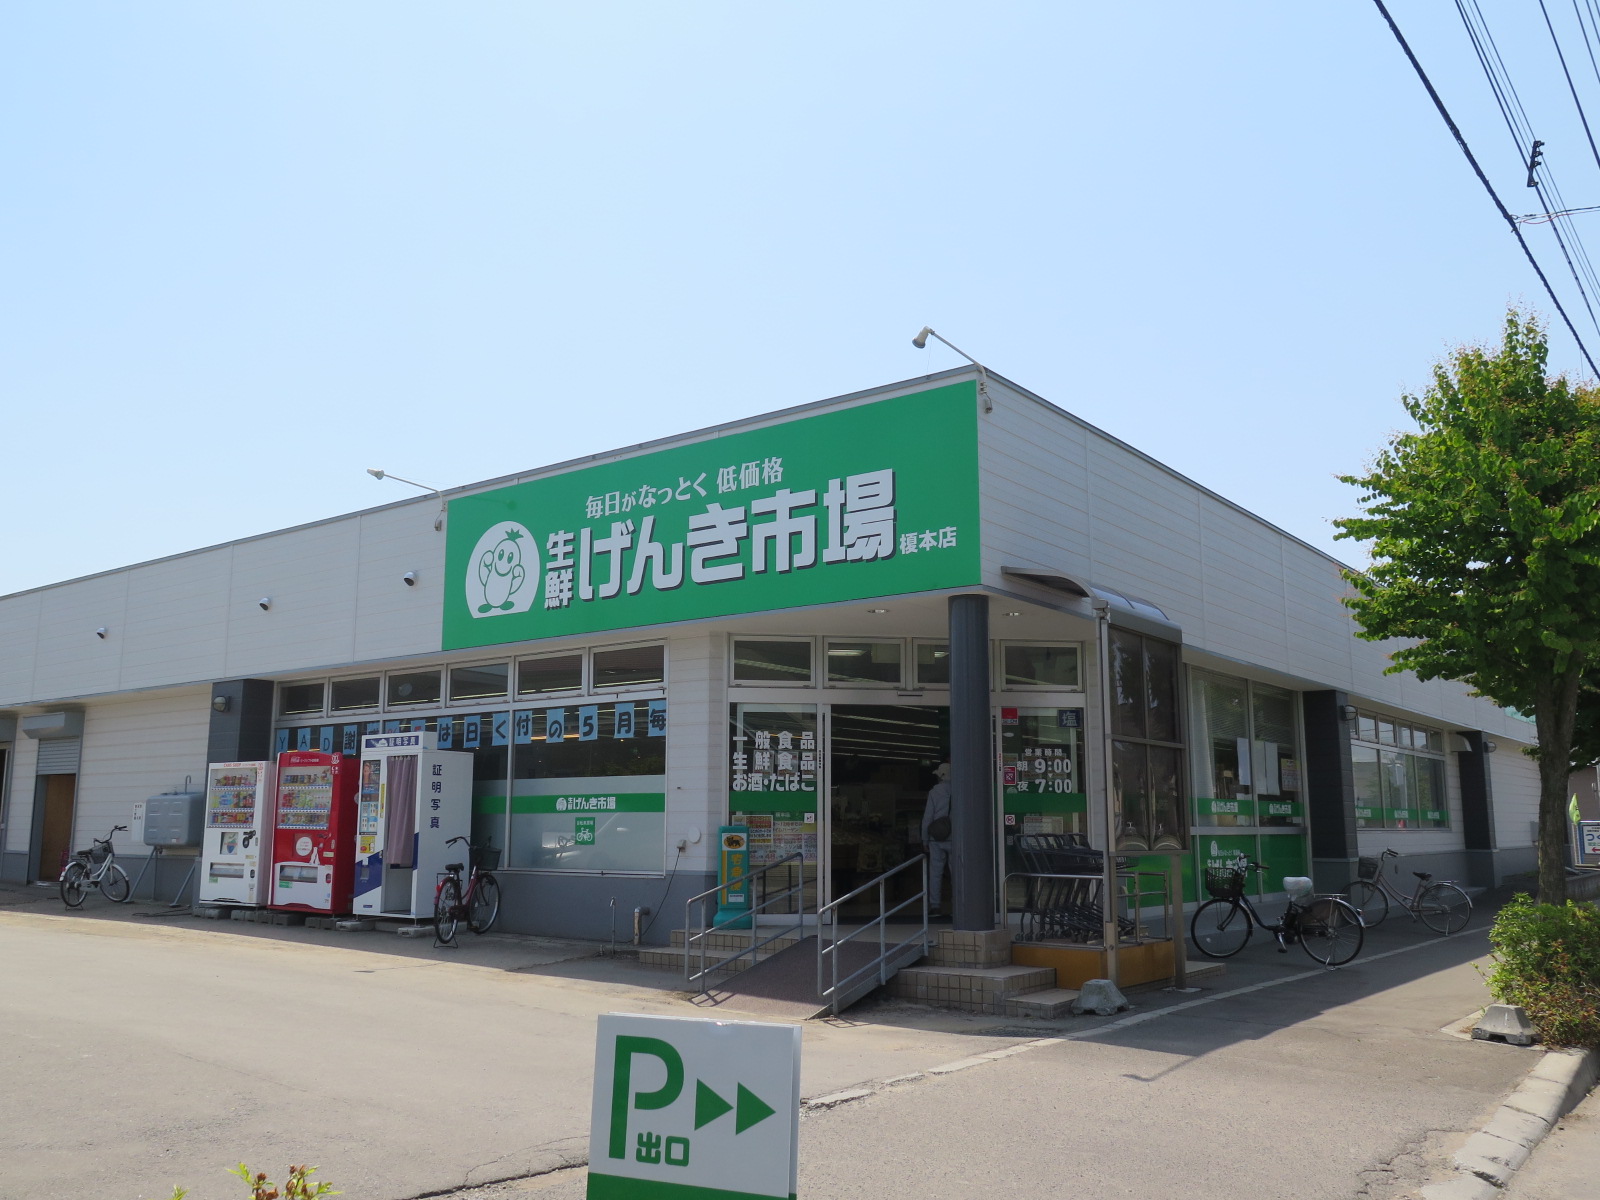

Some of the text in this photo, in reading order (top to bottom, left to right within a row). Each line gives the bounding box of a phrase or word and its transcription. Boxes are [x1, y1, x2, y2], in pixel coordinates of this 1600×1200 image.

[585, 456, 784, 519] 毎日がなっとく 低価格
[544, 467, 896, 609] 生鮮 げんき市場
[899, 526, 958, 555] 榎本店
[1062, 711, 1078, 727] 塩
[388, 736, 417, 747] 証明写真
[733, 731, 815, 750] 一般食品
[733, 751, 815, 770] 生鮮食品
[1025, 748, 1063, 757] 営業時間
[1016, 760, 1028, 772] 朝
[1034, 758, 1072, 774] 9:00
[732, 772, 815, 792] お酒・たばこ
[1017, 779, 1072, 794] 夜 7:00
[430, 764, 443, 829] 証明写真
[573, 796, 616, 810] げんき市場
[608, 1035, 685, 1160] P
[635, 1131, 690, 1167] 出口
